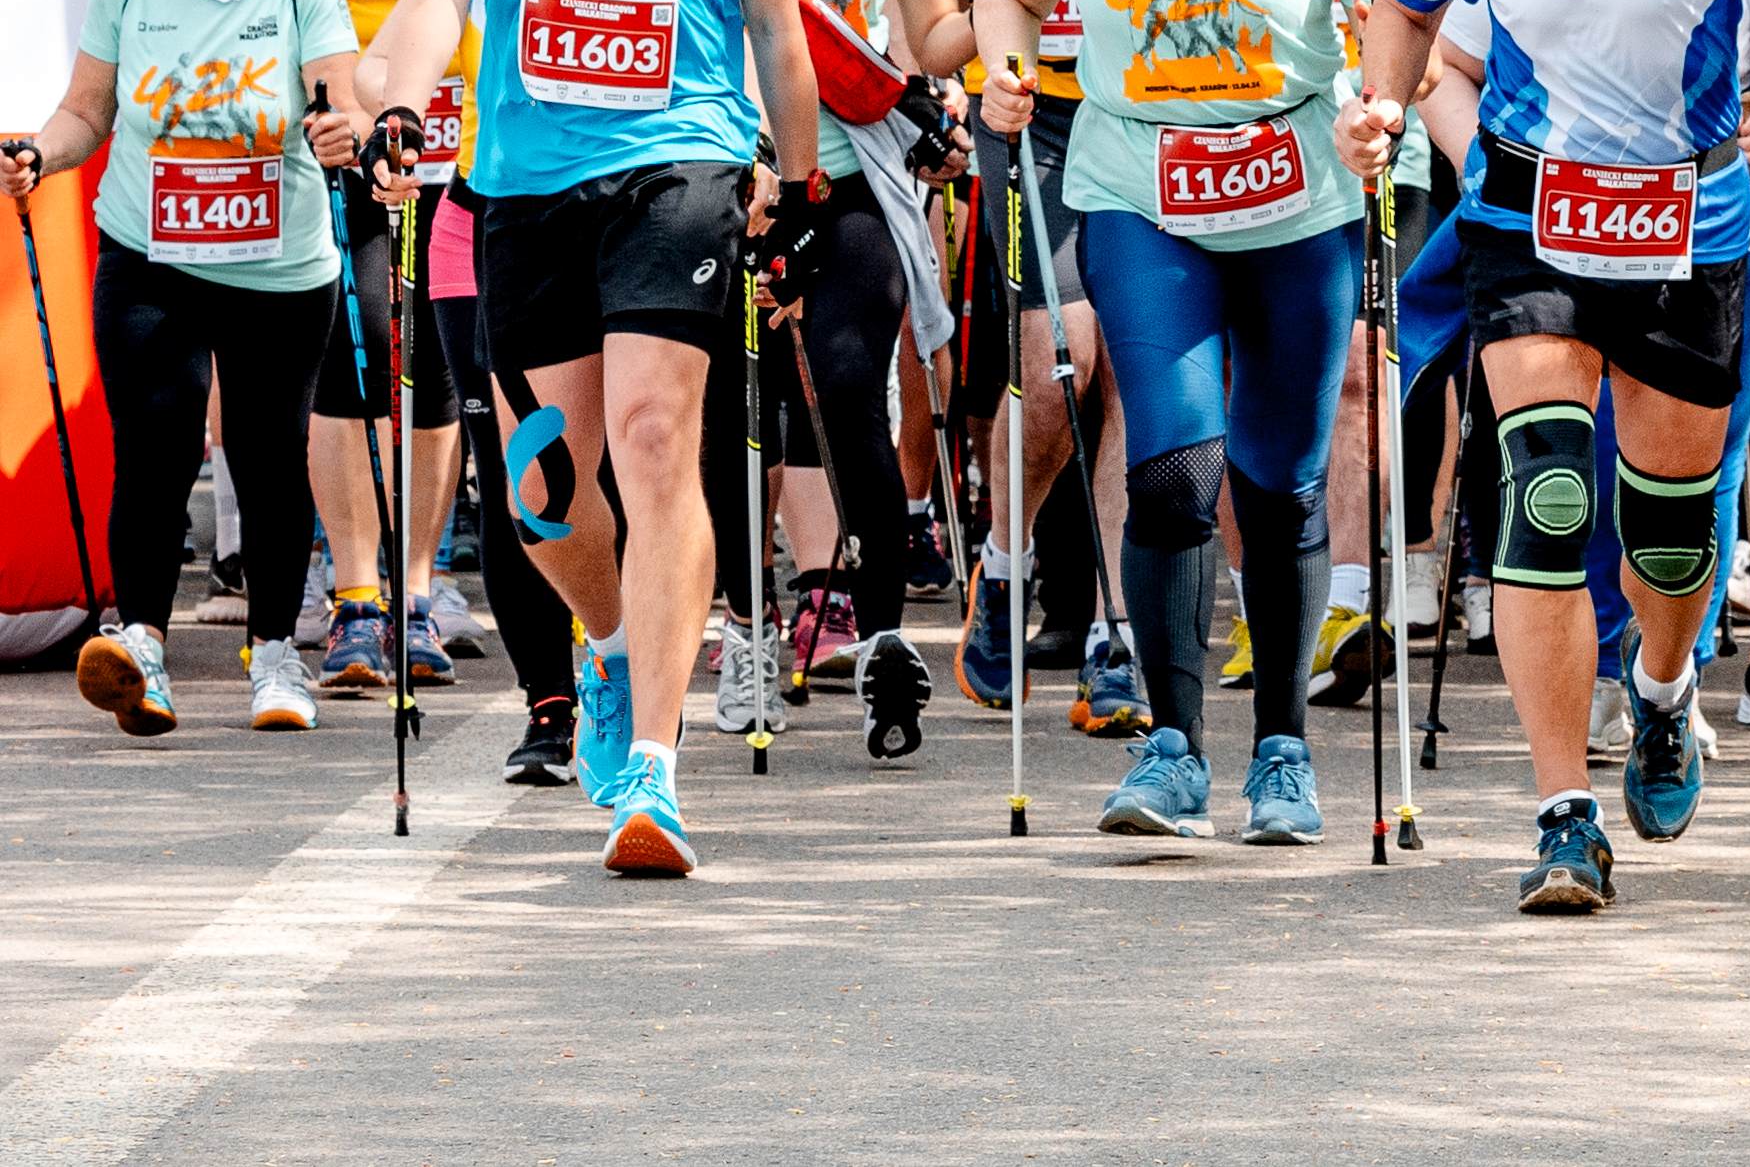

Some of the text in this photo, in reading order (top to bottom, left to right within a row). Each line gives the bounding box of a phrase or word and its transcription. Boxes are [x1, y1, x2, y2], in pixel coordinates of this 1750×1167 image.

[532, 26, 660, 73] 11603
[1170, 147, 1293, 200] 11605
[160, 193, 271, 229] 11401
[1551, 197, 1680, 241] 11466
